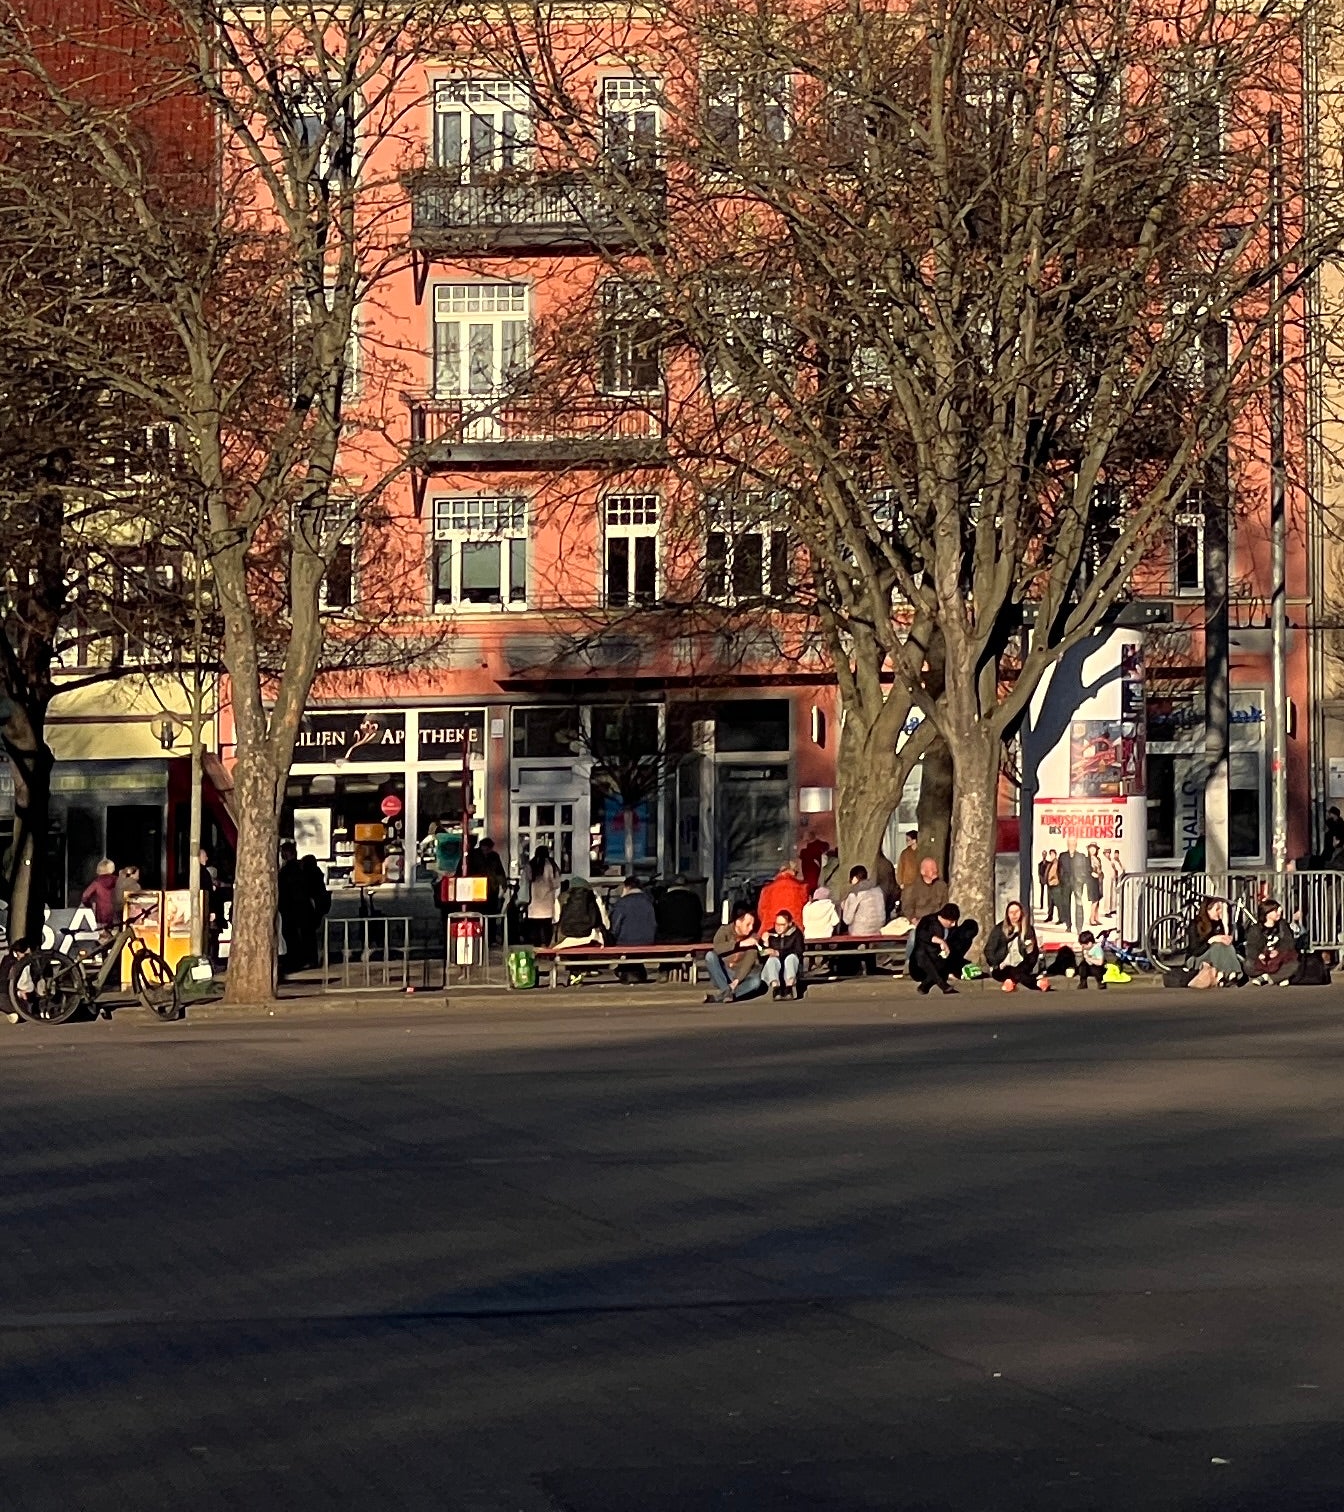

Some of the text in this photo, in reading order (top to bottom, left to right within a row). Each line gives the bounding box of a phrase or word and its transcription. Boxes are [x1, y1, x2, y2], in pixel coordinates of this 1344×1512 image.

[295, 728, 478, 746] ILIEN APTHEKE
[1049, 814, 1124, 838] DES FRIEDENS 2
